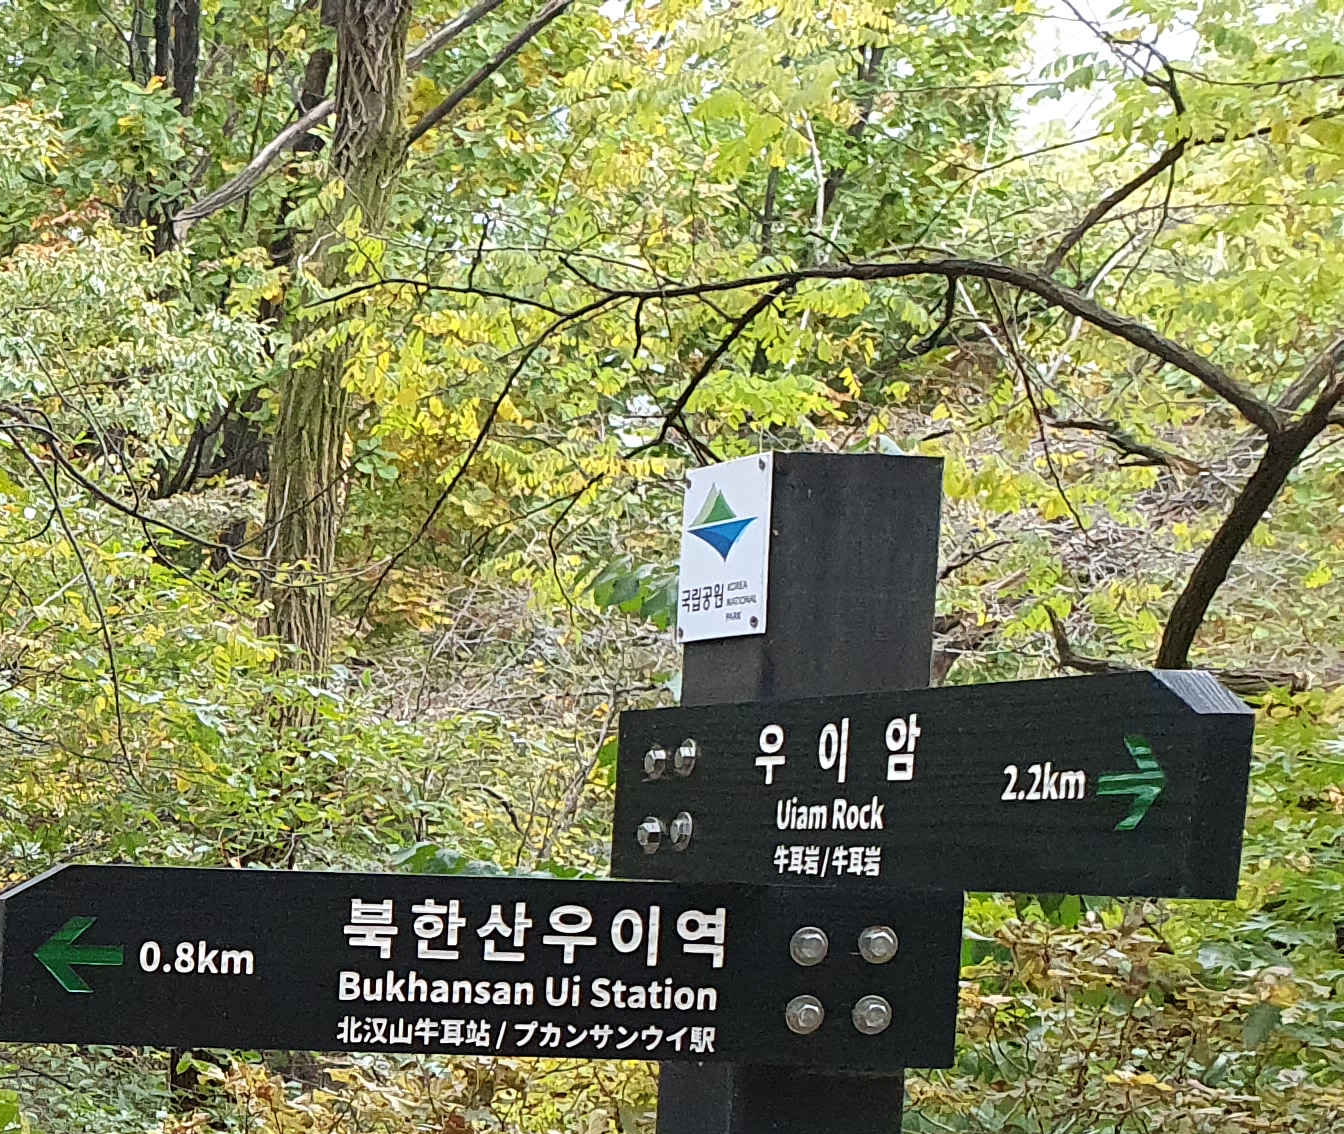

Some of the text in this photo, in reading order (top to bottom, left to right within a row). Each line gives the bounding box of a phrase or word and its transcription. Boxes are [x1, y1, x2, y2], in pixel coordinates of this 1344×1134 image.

[681, 583, 724, 613] 국립공원
[1001, 761, 1086, 801] 2.2km
[776, 795, 885, 830] Uiam Rock
[343, 898, 726, 968] 북한산우이역
[139, 940, 254, 975] 0.8km
[338, 970, 717, 1011] Bukhansan Ui Station
